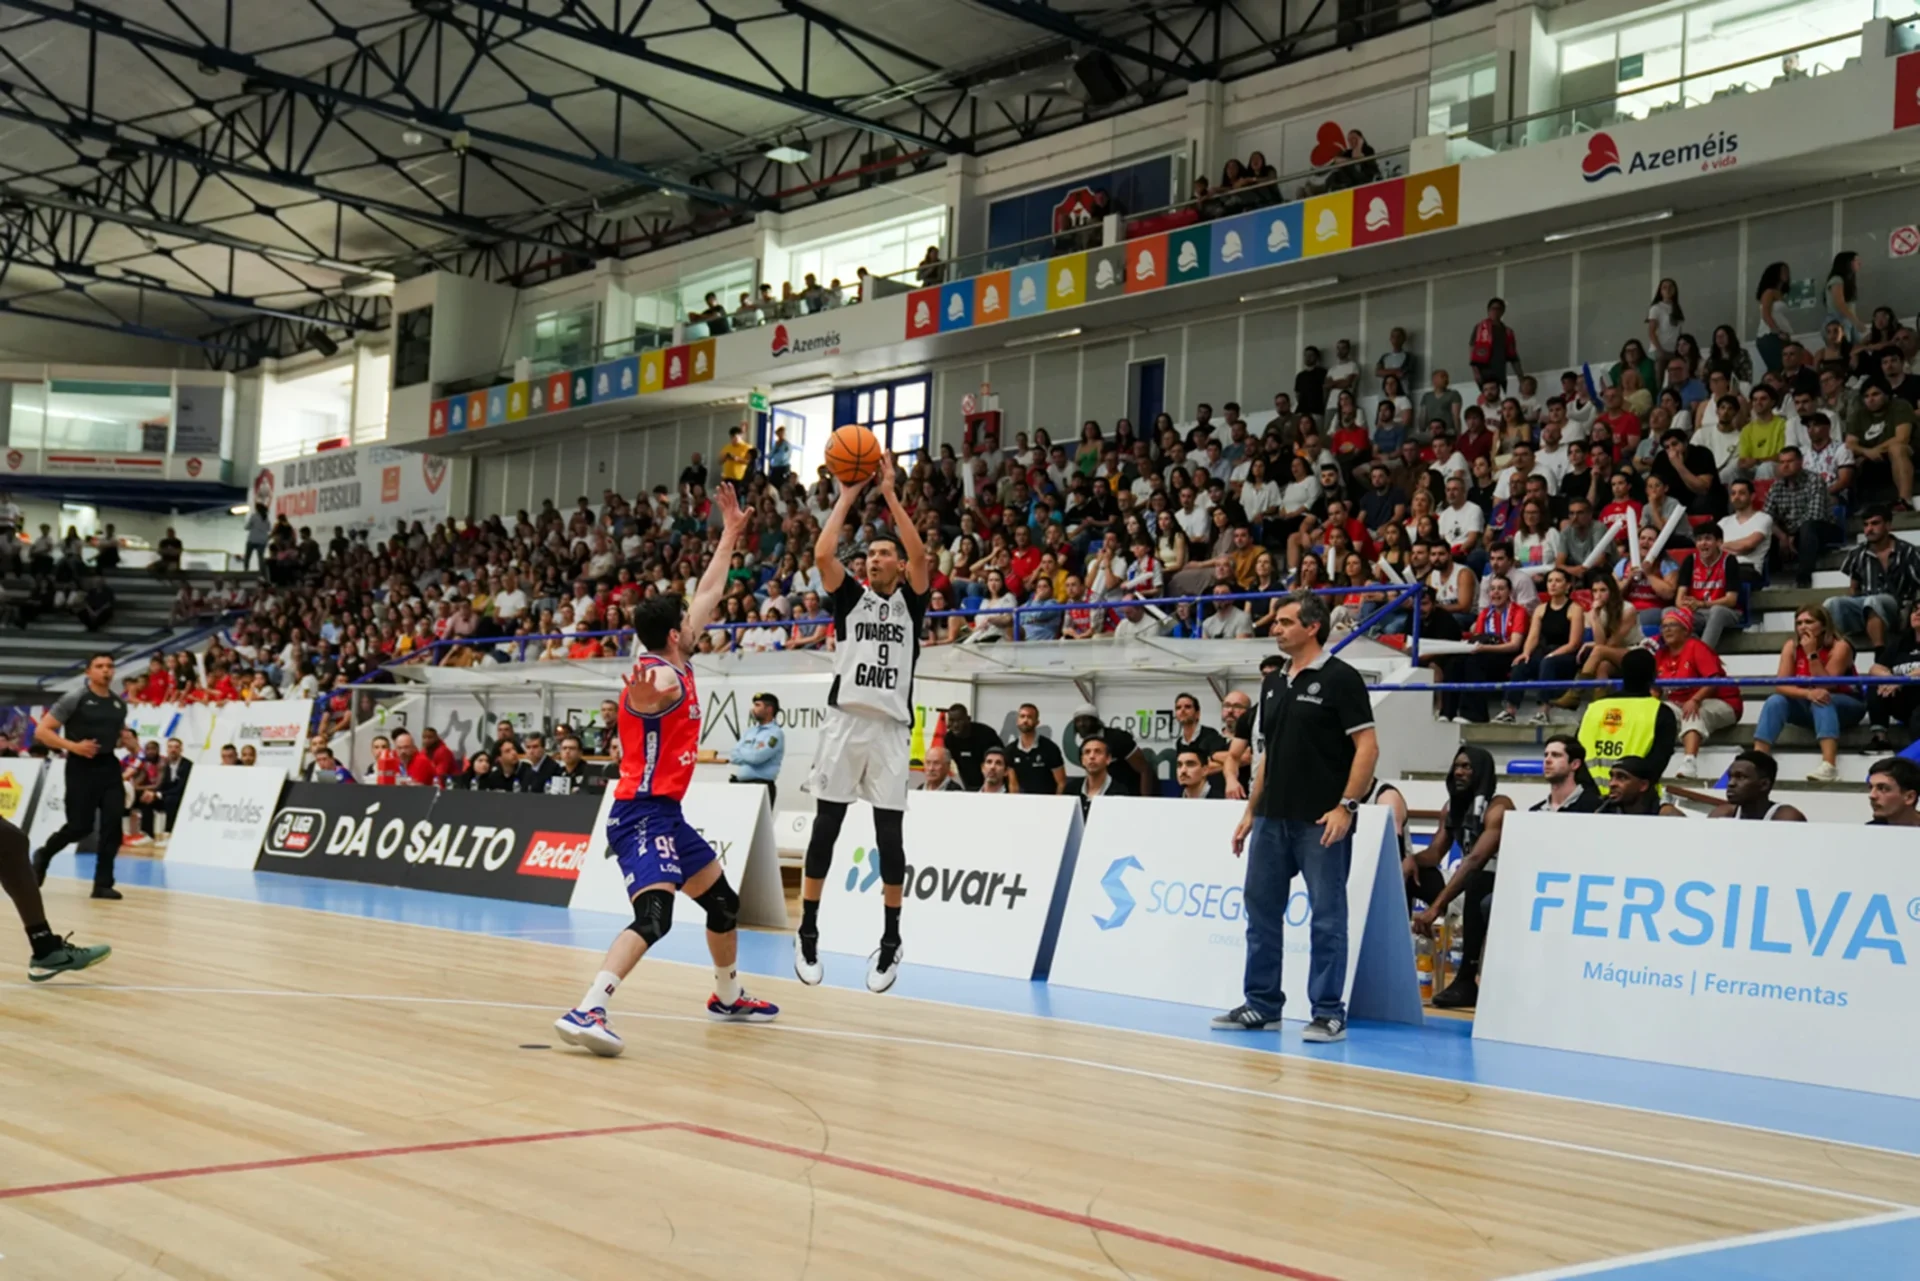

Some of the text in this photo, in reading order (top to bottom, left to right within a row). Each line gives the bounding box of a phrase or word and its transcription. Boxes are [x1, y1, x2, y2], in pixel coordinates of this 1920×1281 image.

[1628, 130, 1738, 174] Azeméis
[1701, 155, 1737, 171] é vida
[792, 330, 841, 354] Azeméis
[297, 450, 358, 486] OLIVEIRENSE
[318, 482, 361, 513] FERSILVA
[877, 644, 889, 666] 9
[1595, 740, 1624, 757] 586
[204, 793, 263, 824] Simoldes
[325, 802, 516, 871] DÁ O SALTO
[1530, 872, 1907, 965] FERSILVA
[1583, 961, 1684, 989] Máquinas
[1705, 973, 1849, 1007] Ferramentas
